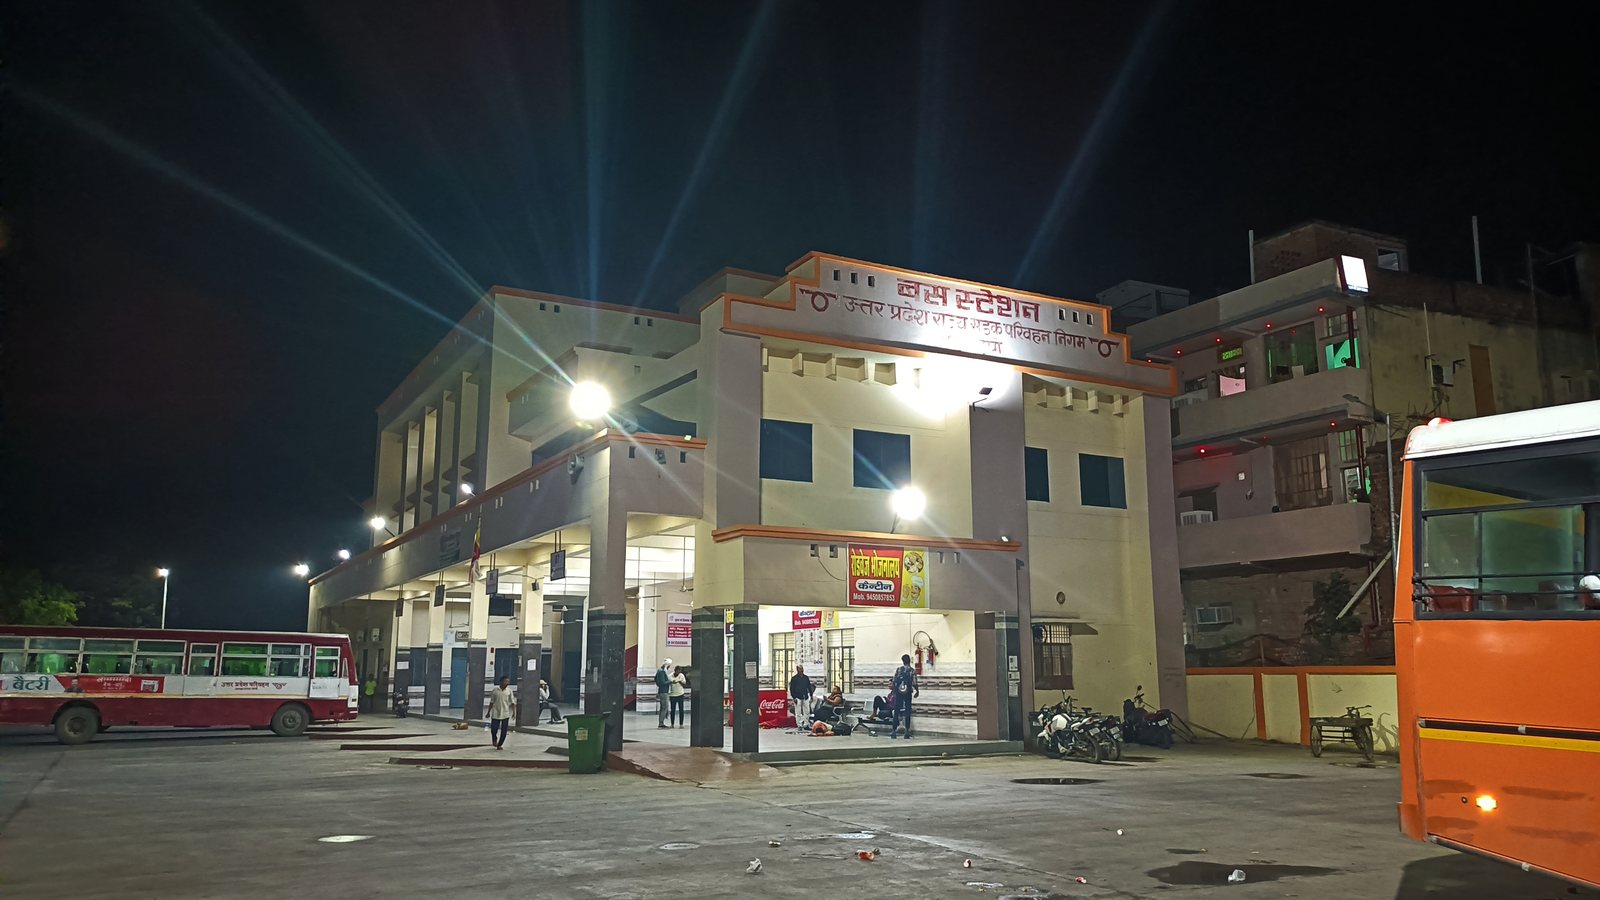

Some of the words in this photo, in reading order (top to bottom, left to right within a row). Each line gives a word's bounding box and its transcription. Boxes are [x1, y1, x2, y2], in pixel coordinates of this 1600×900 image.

[843, 295, 886, 318] उत्तर
[887, 301, 930, 325] प्रदेश
[1003, 321, 1052, 345] परिवहन
[1053, 328, 1088, 350] निगम
[896, 278, 950, 307] बस
[955, 288, 1041, 323] स्टेशन
[12, 675, 51, 690] बैटरी
